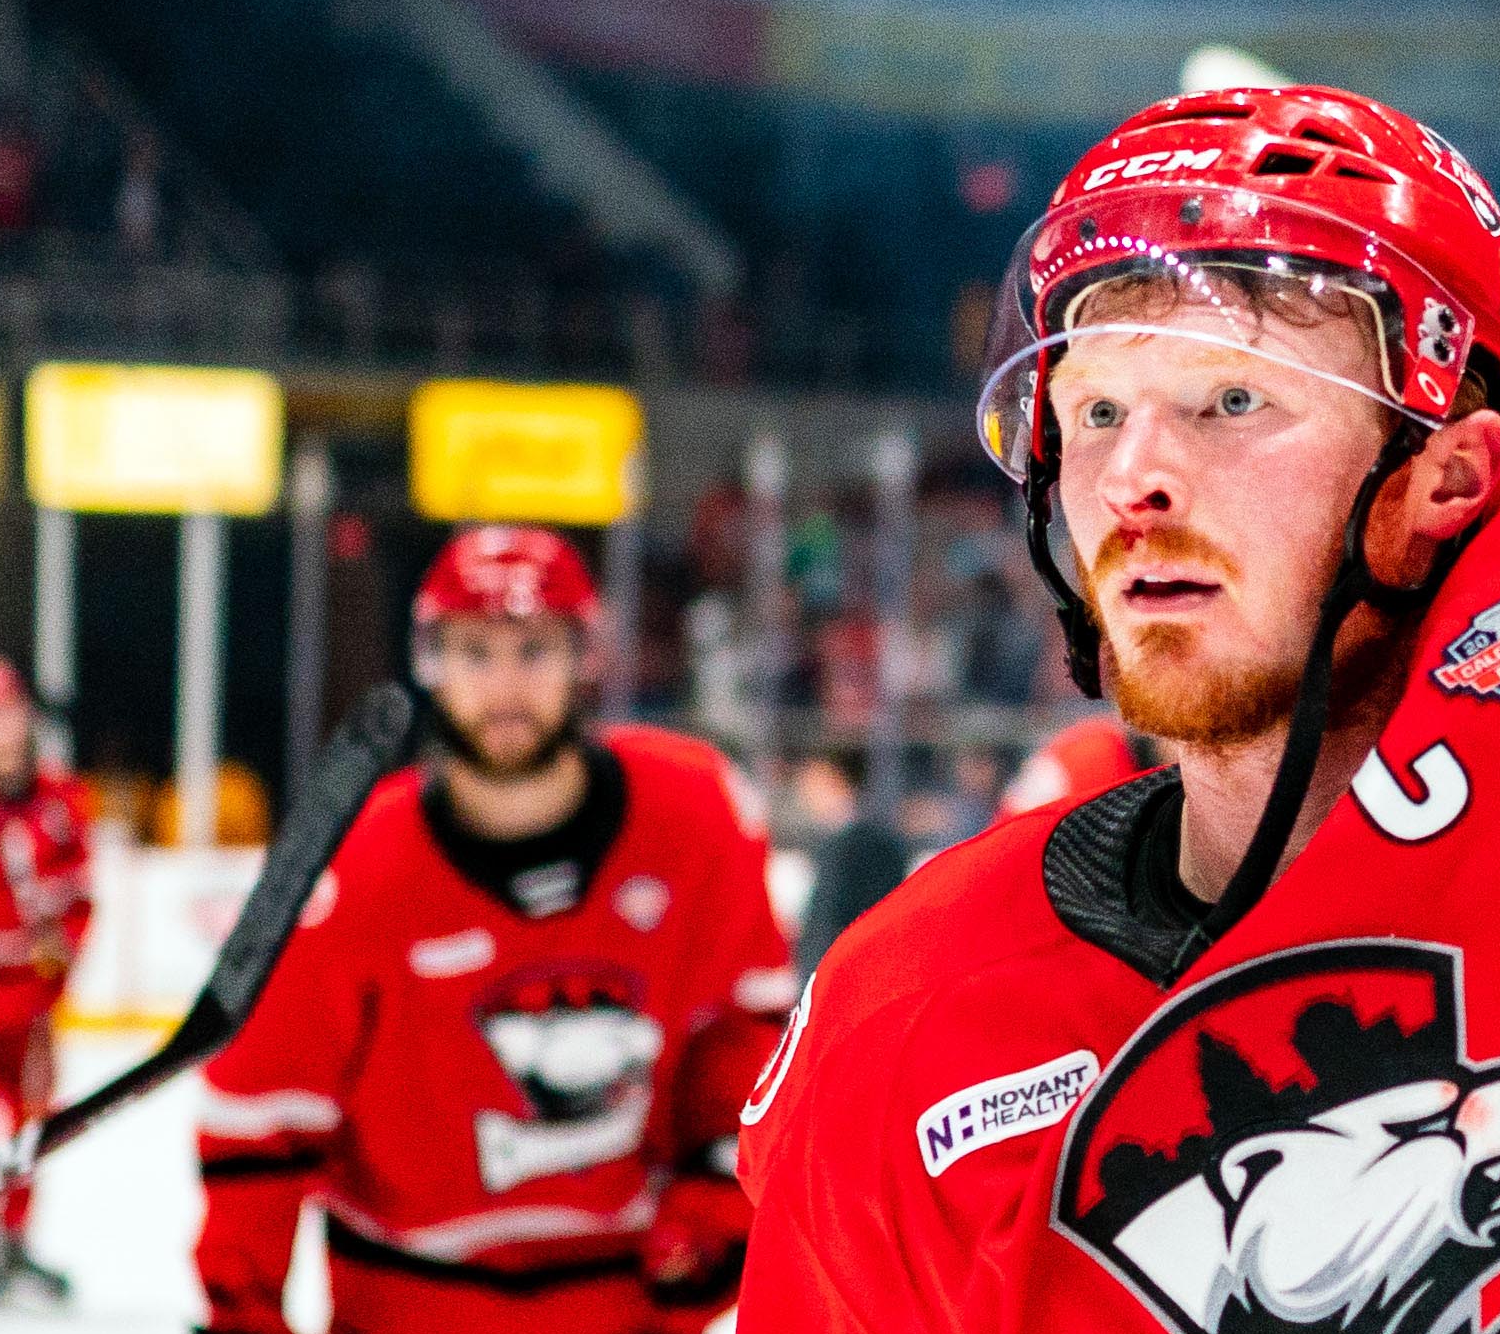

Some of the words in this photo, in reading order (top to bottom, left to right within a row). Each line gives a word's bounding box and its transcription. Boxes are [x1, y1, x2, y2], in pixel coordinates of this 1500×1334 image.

[1083, 148, 1222, 191] CCM
[1352, 742, 1470, 842] C
[981, 1065, 1088, 1108] NOVANT
[981, 1091, 1080, 1132] HEALTH
